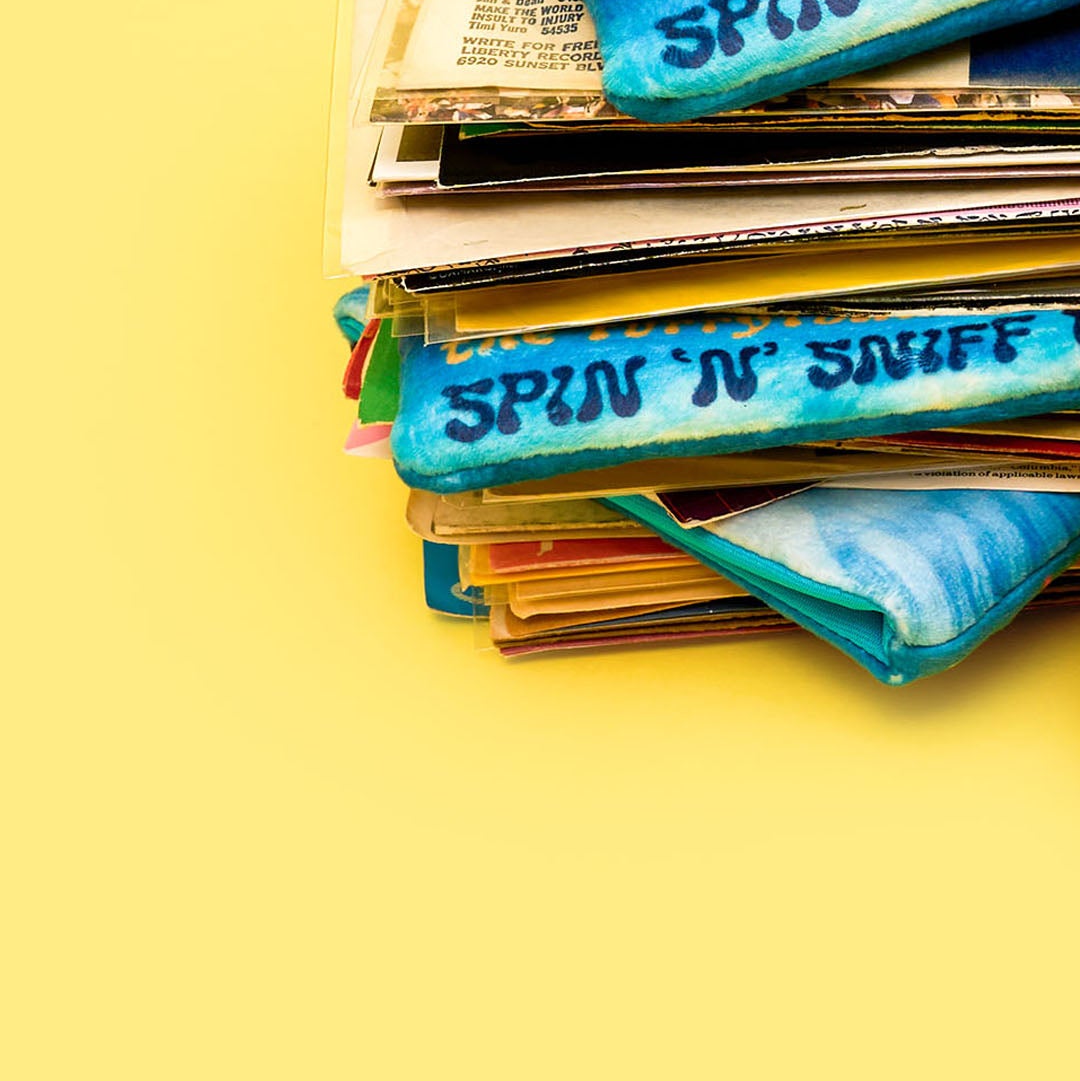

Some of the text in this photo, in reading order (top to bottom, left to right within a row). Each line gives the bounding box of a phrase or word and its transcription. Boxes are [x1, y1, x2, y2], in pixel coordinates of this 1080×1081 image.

[474, 4, 584, 17] MAKE THE WORLD
[471, 12, 584, 26] INSULT TO INJURY
[468, 21, 578, 35] Timi Yuro 54535
[462, 37, 516, 49] WRITE
[522, 42, 556, 51] FOR
[461, 46, 602, 62] LIBERTY RECORD
[456, 56, 604, 72] 6920 SUNSET BLV
[441, 355, 647, 443] SPIN
[805, 314, 1037, 391] SNIFF
[979, 470, 990, 478] of
[992, 471, 1053, 480] applicable
